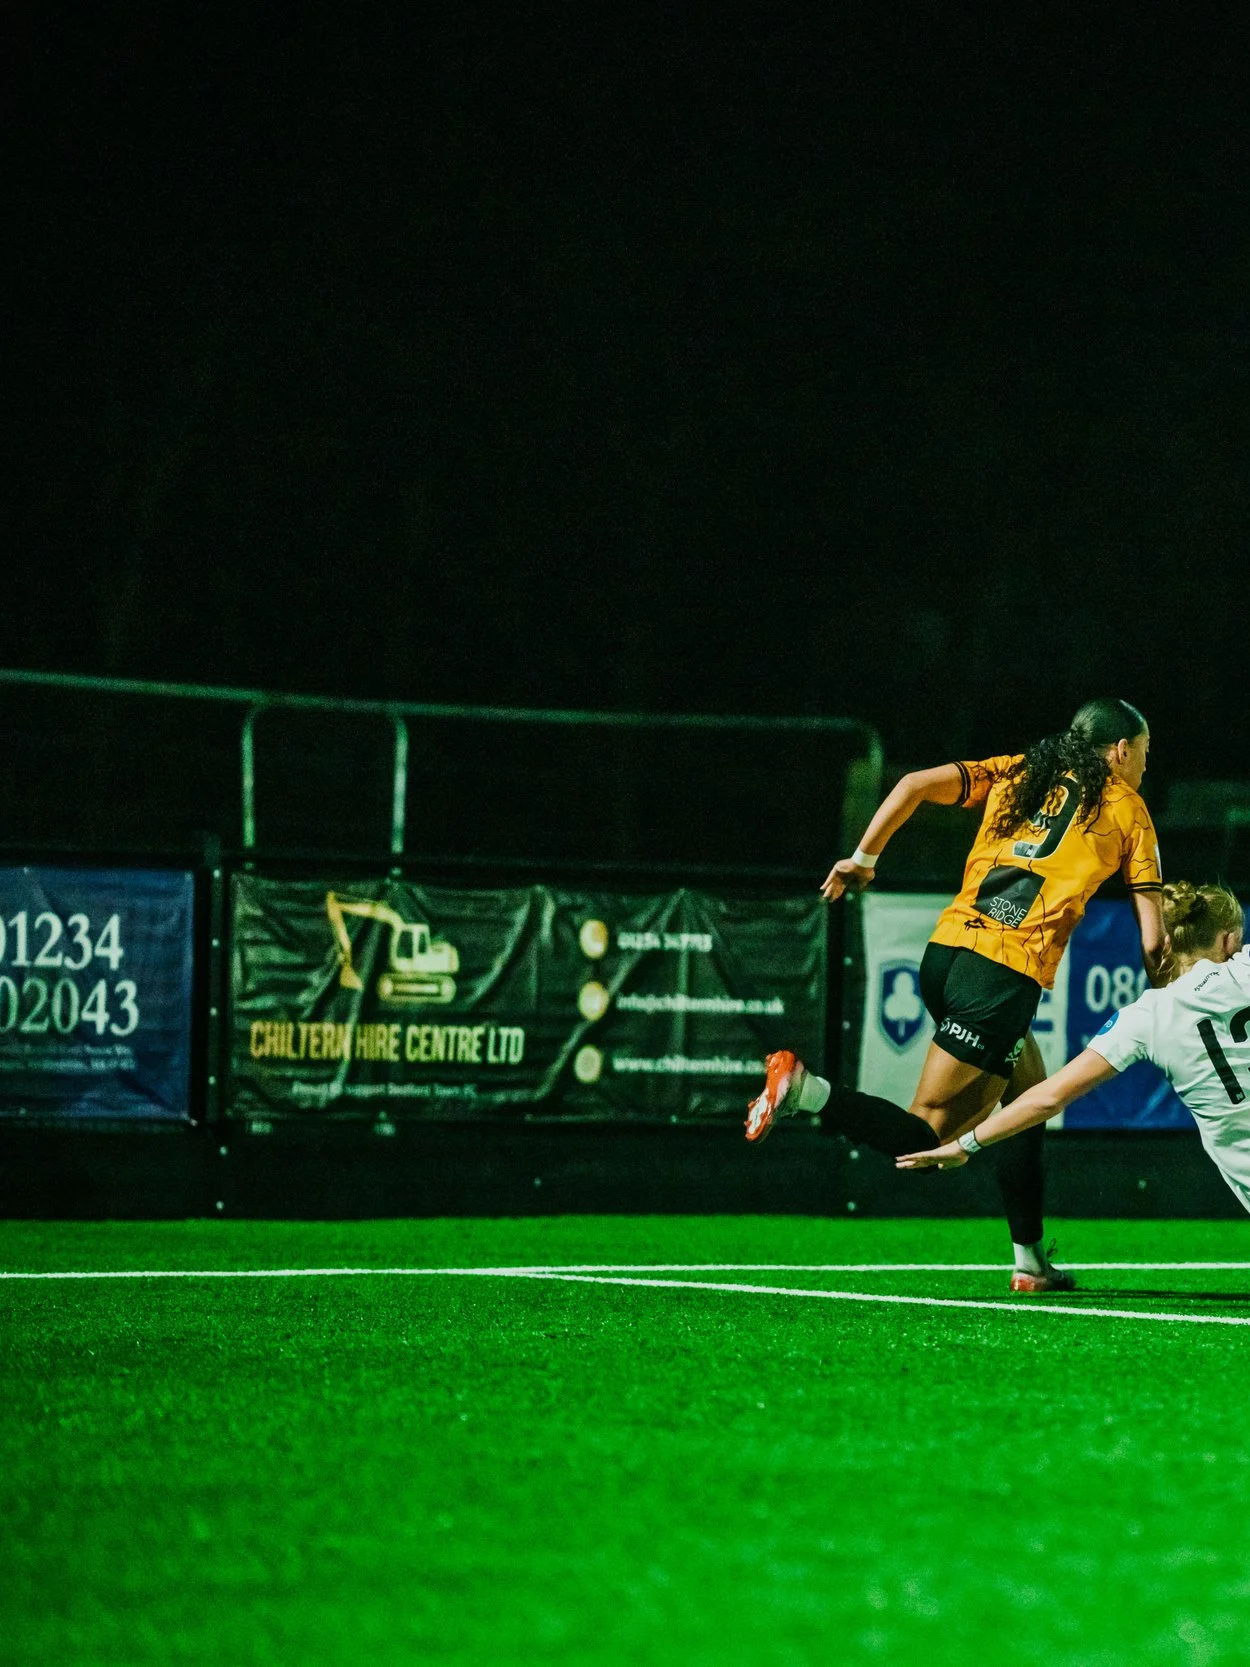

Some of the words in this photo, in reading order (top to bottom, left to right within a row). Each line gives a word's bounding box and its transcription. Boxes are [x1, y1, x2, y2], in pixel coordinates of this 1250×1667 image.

[987, 907, 1022, 928] RIDGE
[989, 896, 1028, 922] STONE
[0, 910, 124, 971] 1234
[250, 1020, 351, 1061] CHILTERN
[355, 1022, 402, 1062] HIRE
[405, 1024, 482, 1063] CENTRE
[487, 1025, 525, 1064] LTD
[949, 1022, 980, 1047] PJH
